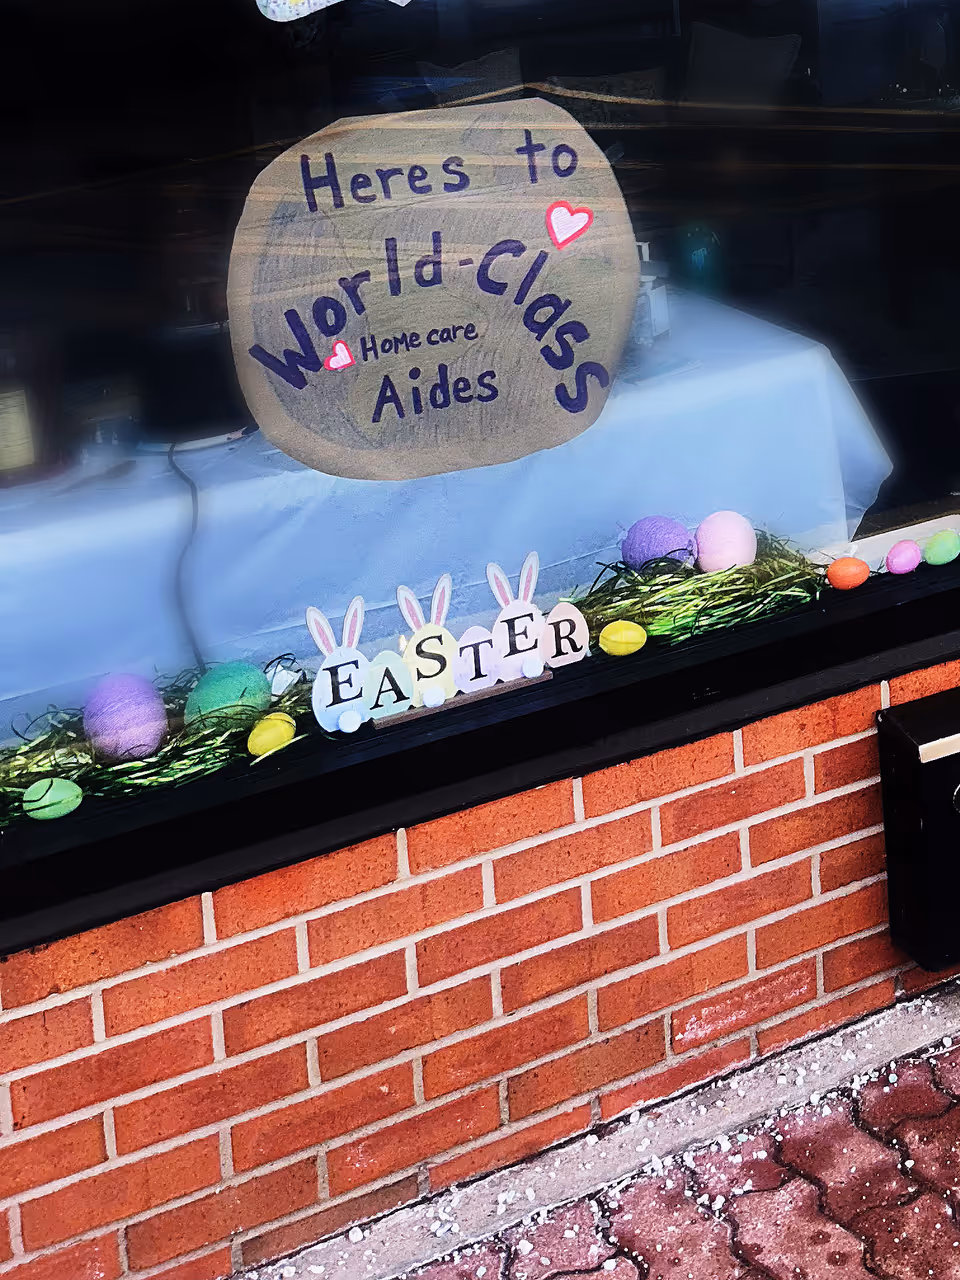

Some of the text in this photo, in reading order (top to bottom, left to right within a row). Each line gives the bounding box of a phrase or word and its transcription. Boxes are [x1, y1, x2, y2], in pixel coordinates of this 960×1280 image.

[300, 129, 579, 212] Heres to
[426, 319, 479, 342] care
[371, 363, 499, 423] Aides
[322, 613, 584, 711] EASTER
